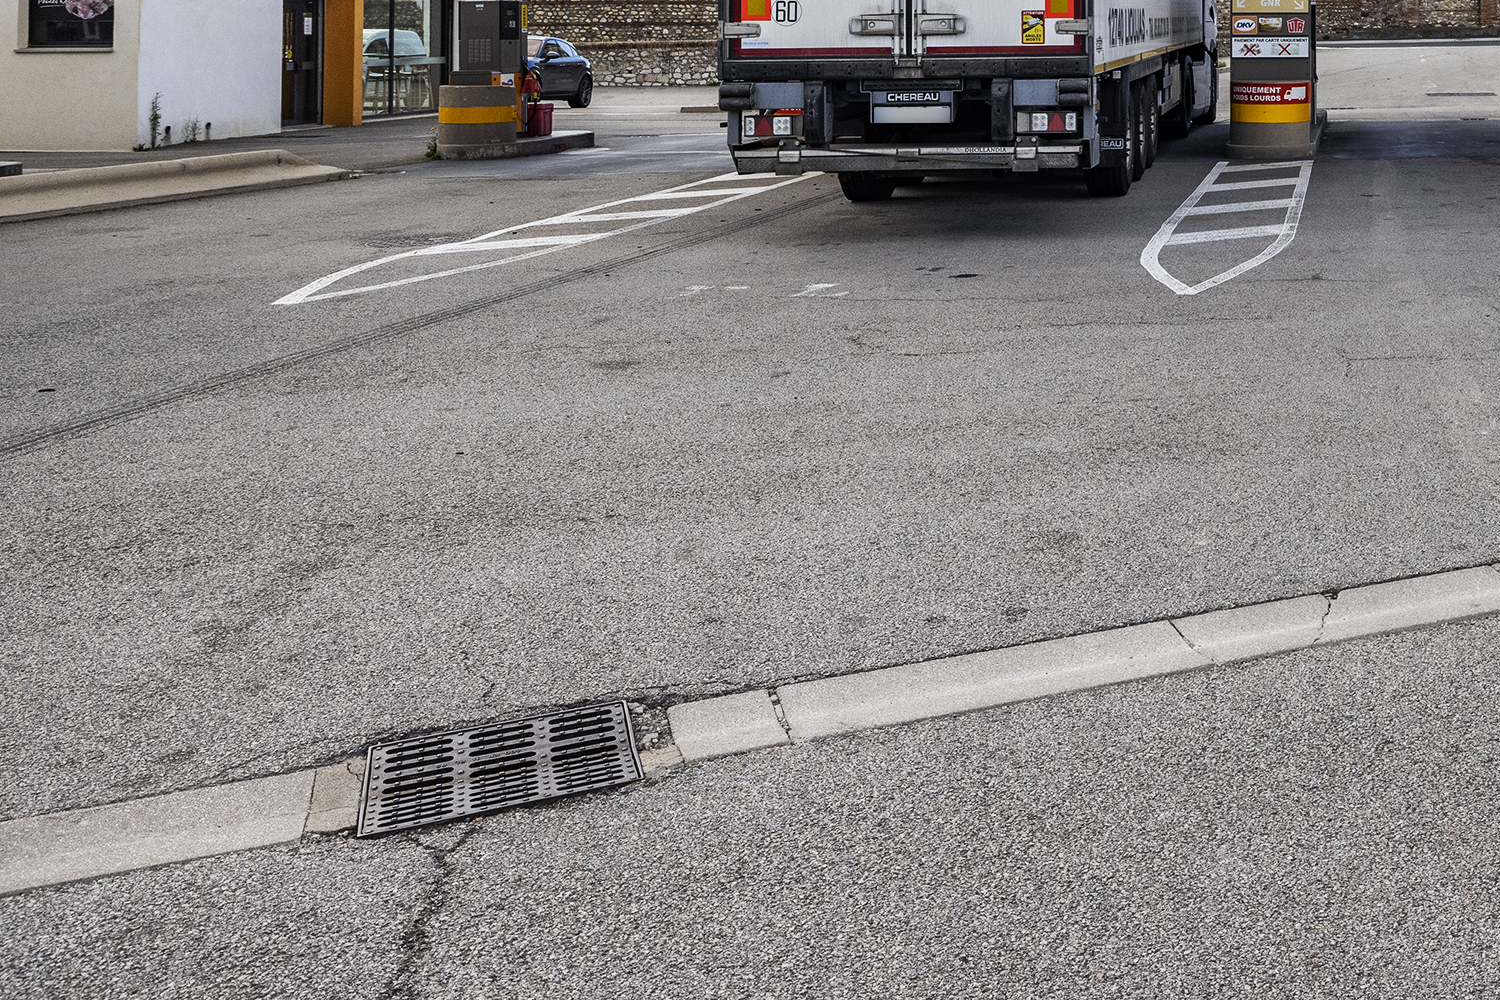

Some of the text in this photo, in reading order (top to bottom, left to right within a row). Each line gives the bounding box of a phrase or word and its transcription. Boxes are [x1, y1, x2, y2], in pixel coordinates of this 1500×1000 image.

[775, 0, 798, 22] 60
[1287, 18, 1305, 33] UTA
[1233, 86, 1281, 94] UNIQUEMENT
[887, 92, 939, 101] CHEREAU
[1249, 94, 1281, 102] LOURDS
